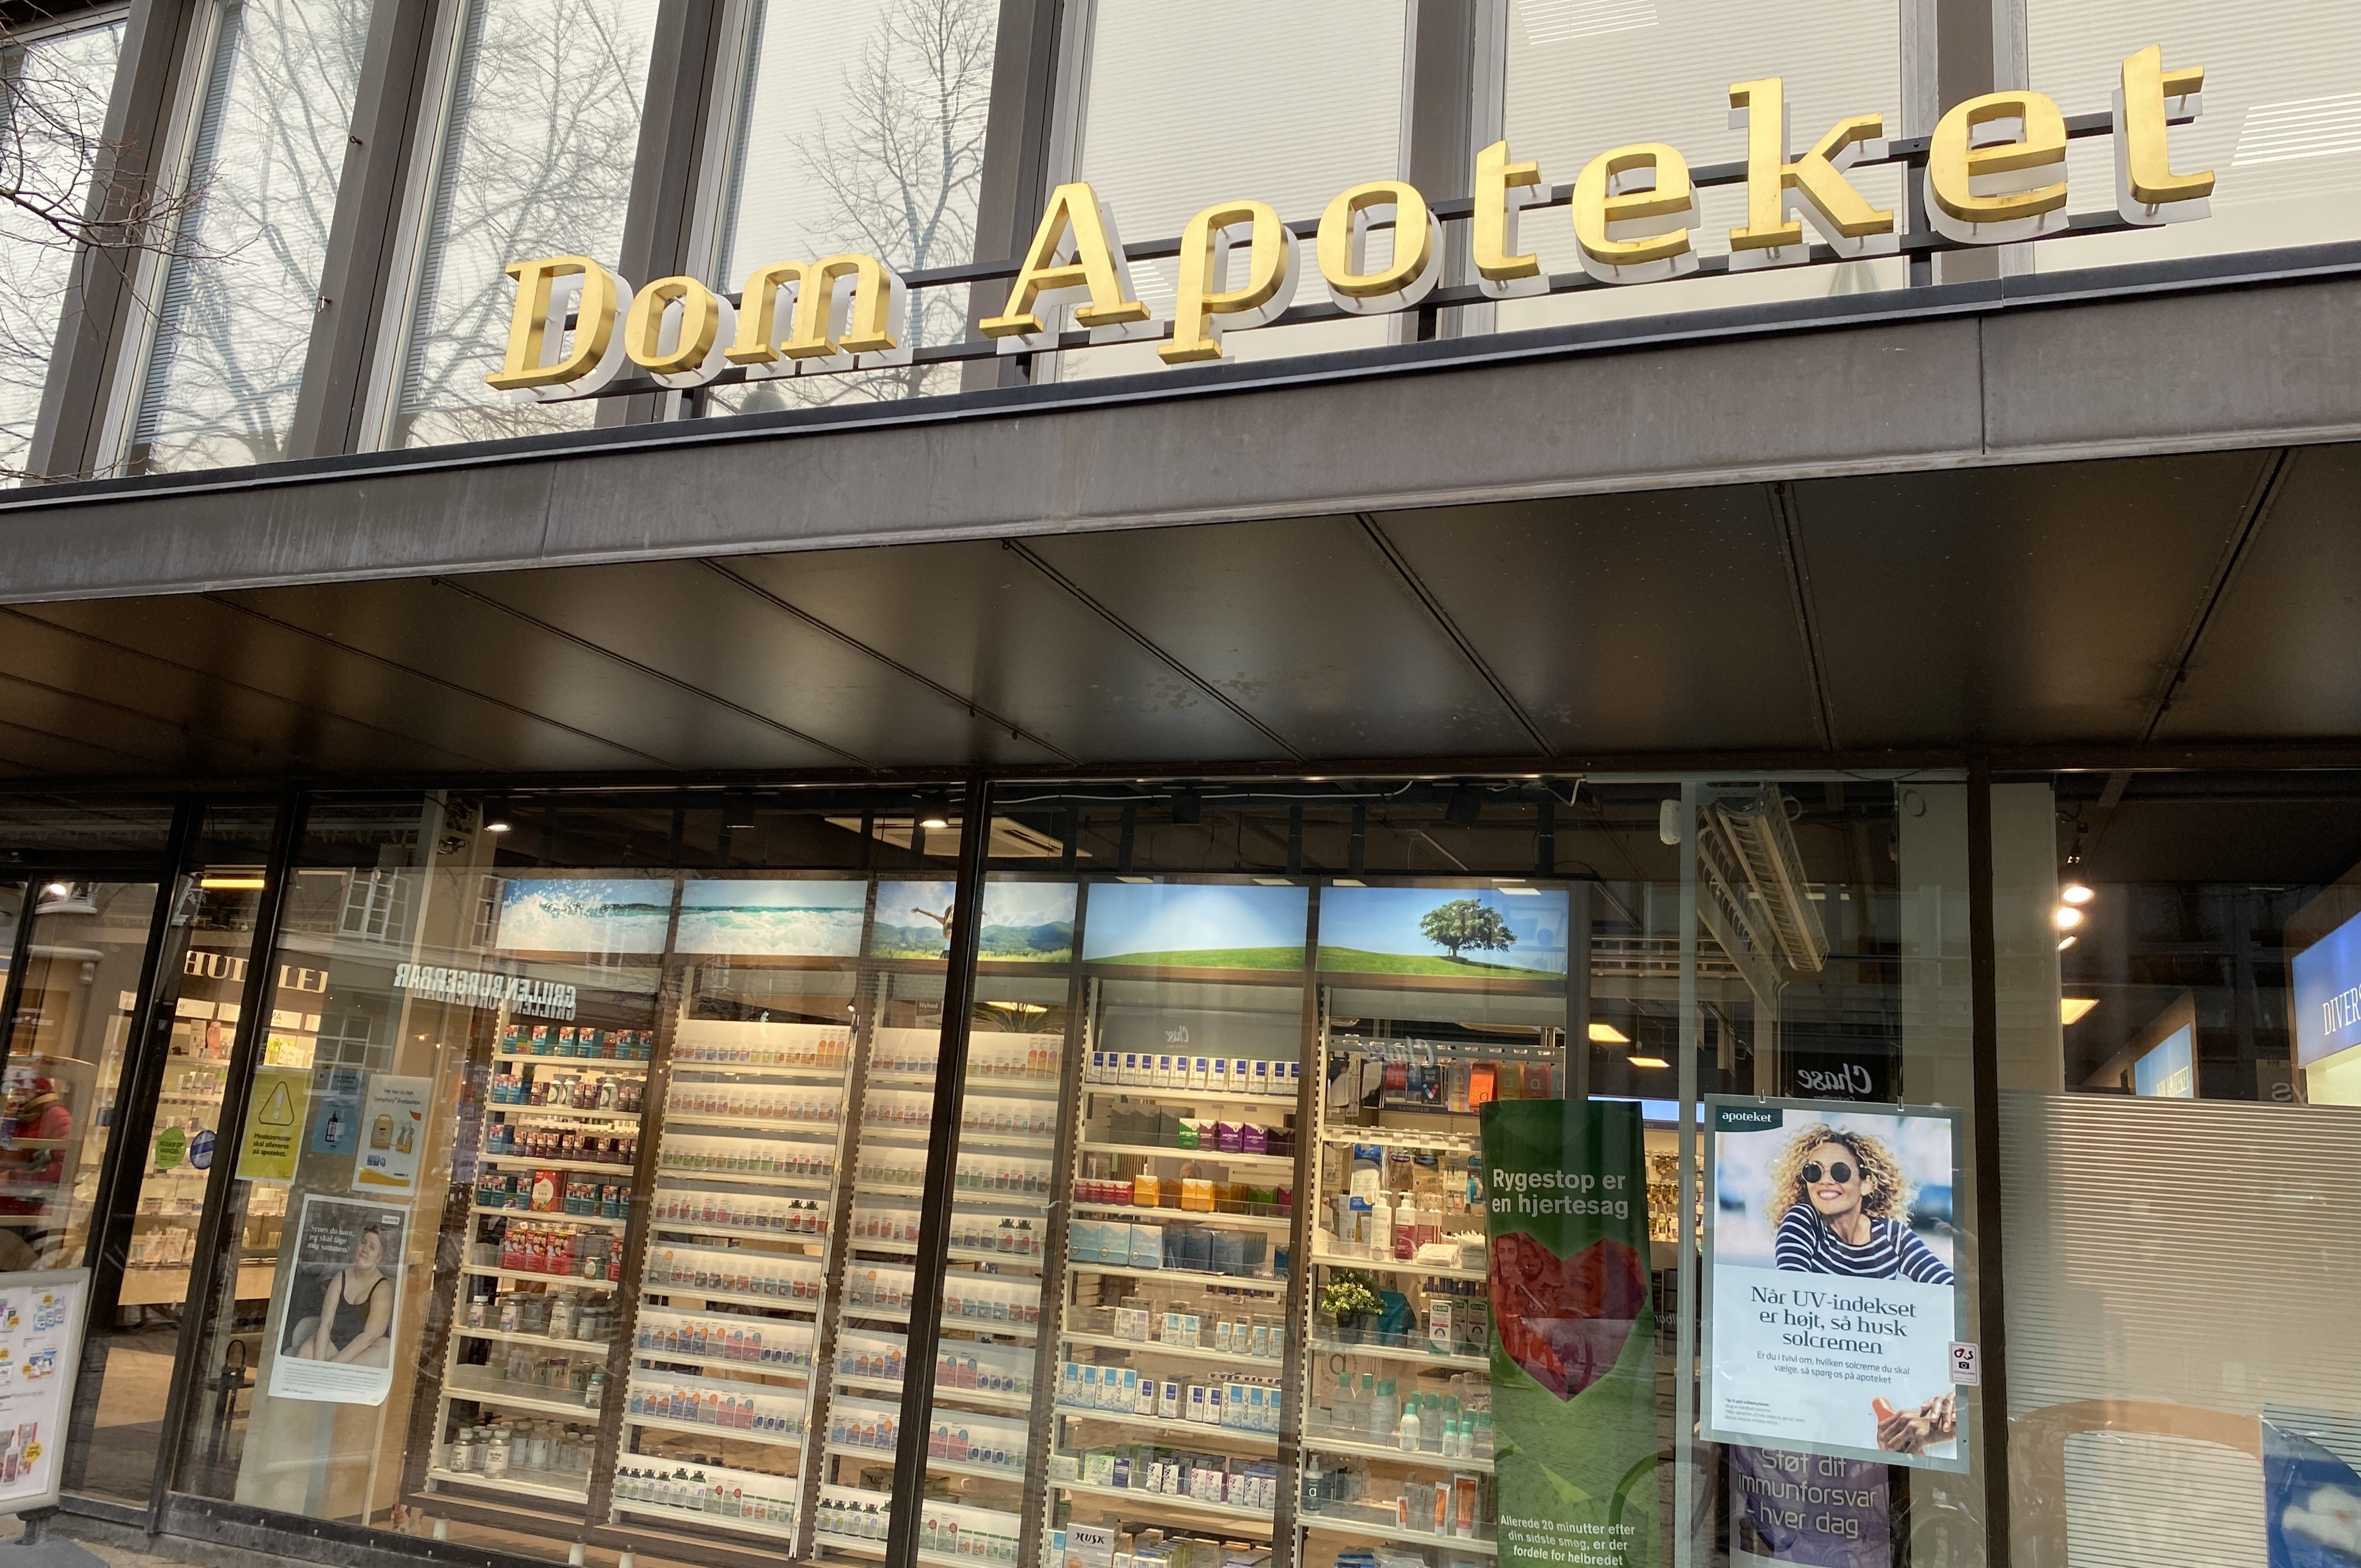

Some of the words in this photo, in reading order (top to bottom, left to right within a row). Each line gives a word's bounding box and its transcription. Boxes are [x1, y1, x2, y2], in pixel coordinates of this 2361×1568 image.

[485, 253, 897, 390] Dom
[980, 44, 2215, 364] Apoteket
[1722, 1110, 1773, 1123] apoteket
[254, 1133, 292, 1142] Medicinrester
[1493, 1169, 1595, 1193] Rygestop
[1602, 1174, 1626, 1190] er
[1491, 1197, 1511, 1213] en
[1518, 1193, 1628, 1220] hjertesag
[307, 1242, 320, 1251] mig
[309, 1234, 319, 1242] jeg
[334, 1237, 347, 1246] tage
[1751, 1286, 1787, 1304] Når
[1791, 1289, 1917, 1319] UV-indekset
[1759, 1311, 1778, 1324] er
[1783, 1309, 1826, 1331] højt,
[1830, 1315, 1852, 1332] så
[1857, 1317, 1907, 1337] husk
[1782, 1332, 1883, 1355] solcremen
[1757, 1351, 1766, 1359] Er
[1767, 1352, 1776, 1360] du
[1782, 1353, 1798, 1363] tvivl
[1815, 1357, 1843, 1368] hvilken
[1845, 1362, 1881, 1372] solcreme
[1882, 1365, 1893, 1373] du
[1894, 1366, 1910, 1375] skal
[1774, 1365, 1799, 1375] vælge,
[1801, 1367, 1809, 1375] så
[1811, 1368, 1833, 1379] spørg
[1845, 1372, 1854, 1381] på
[1856, 1374, 1891, 1384] apoteket
[1761, 1448, 1810, 1474] Støt
[1818, 1456, 1846, 1478] dit
[1738, 1472, 1876, 1508] immunforsvar
[1500, 1514, 1539, 1529] Allerede
[1542, 1519, 1554, 1531] 20
[1556, 1522, 1605, 1535] minutter
[1608, 1524, 1635, 1535] efter
[1760, 1502, 1806, 1529] hver
[1816, 1512, 1859, 1539] dag
[1075, 1532, 1106, 1545] HUSK
[1508, 1531, 1523, 1542] din
[1525, 1532, 1556, 1545] sidste
[1559, 1538, 1590, 1552] smøg,
[1593, 1540, 1606, 1550] er
[1609, 1539, 1628, 1551] der
[1513, 1545, 1548, 1560] fordele
[1551, 1549, 1565, 1561] for
[1568, 1551, 1623, 1566] helbredet
